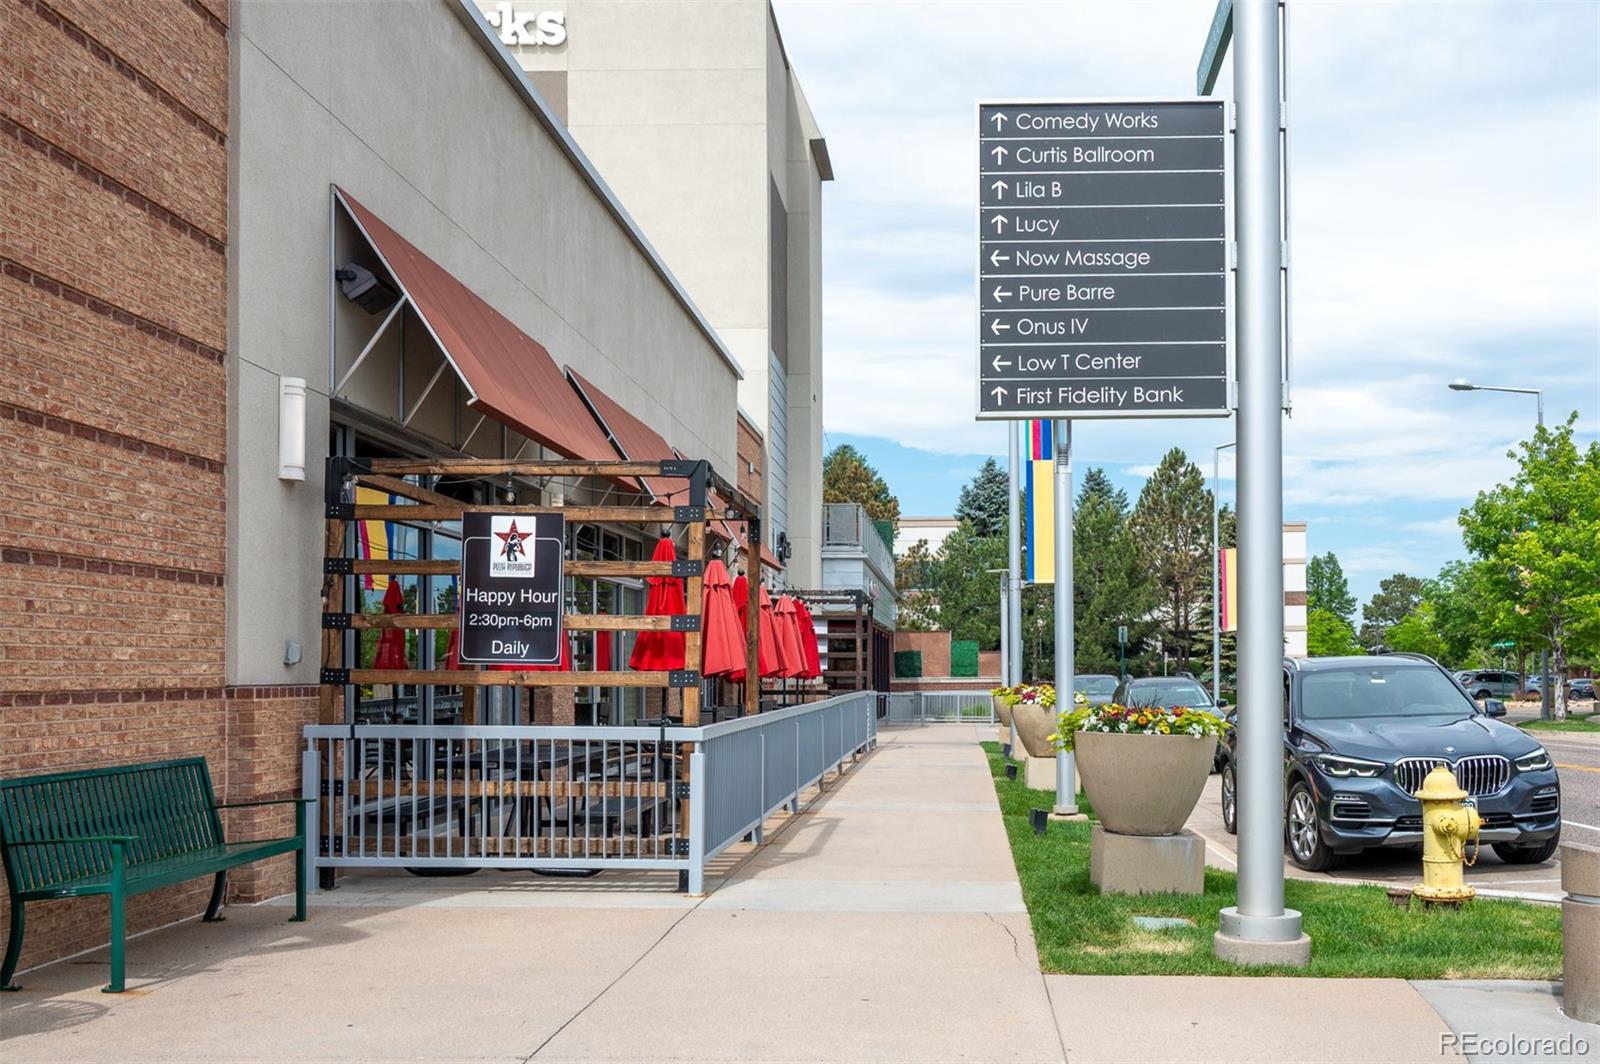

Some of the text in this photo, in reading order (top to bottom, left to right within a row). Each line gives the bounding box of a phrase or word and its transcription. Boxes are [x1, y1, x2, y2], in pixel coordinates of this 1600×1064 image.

[1015, 111, 1158, 133] Comedy Works
[1016, 146, 1155, 164] Curtis Ballroom
[1016, 181, 1062, 198] Lila B
[1016, 215, 1060, 236] Lucy
[1016, 249, 1151, 269] Now Massage
[1019, 284, 1116, 302] Pure Barre
[1016, 318, 1089, 336] Onus IV
[1018, 352, 1142, 372] Low T Center
[1017, 385, 1184, 407] First Fidelity Bank
[467, 588, 558, 606] Happy Hour
[469, 613, 553, 630] 2:30pm-6pm
[491, 640, 530, 658] Daily
